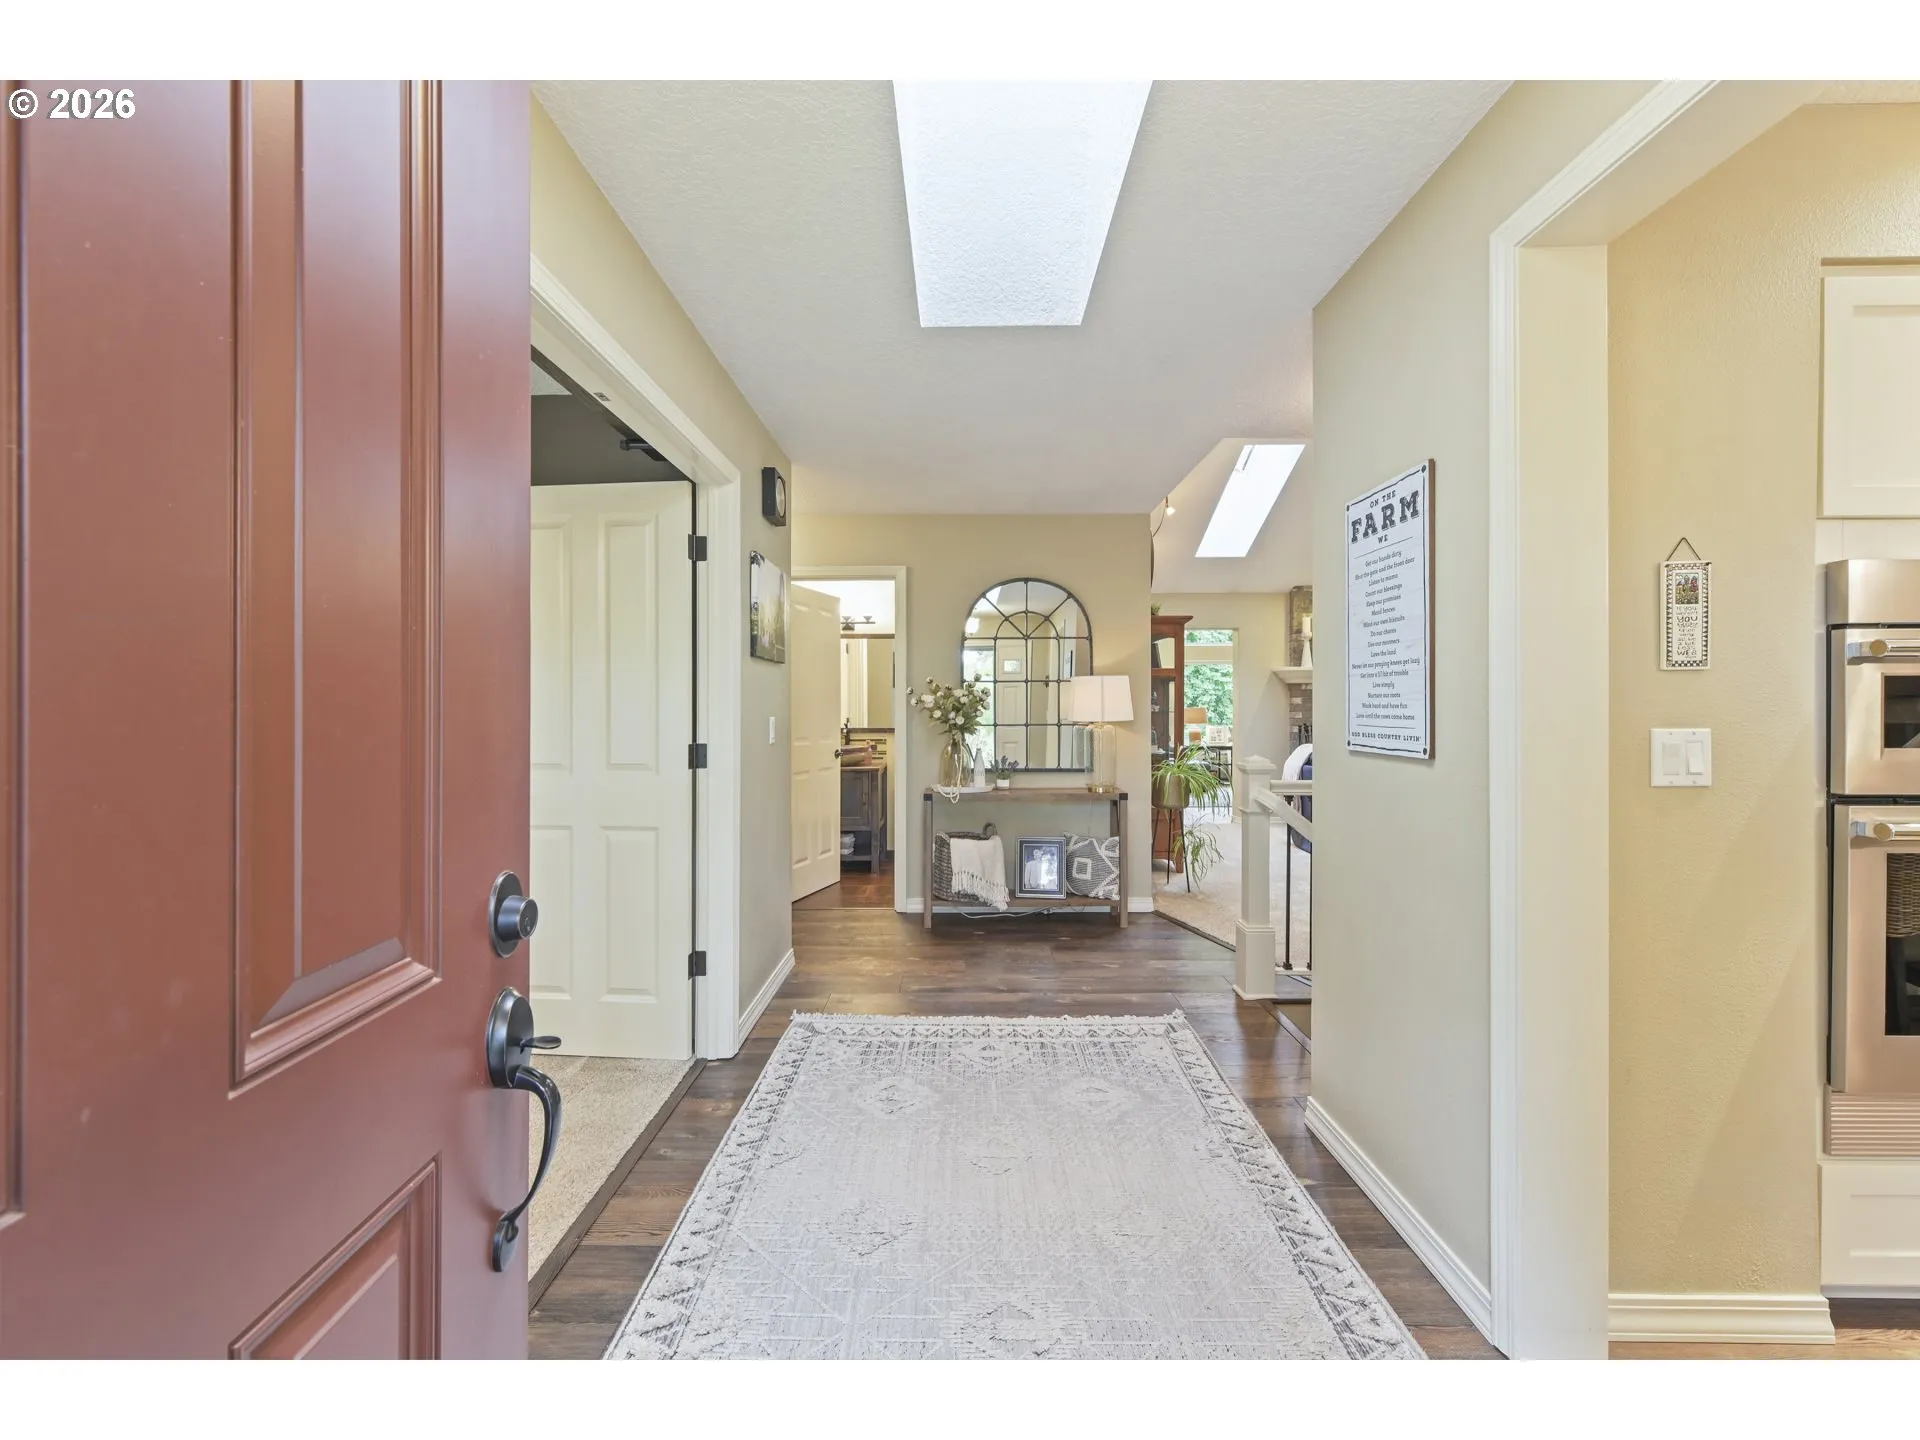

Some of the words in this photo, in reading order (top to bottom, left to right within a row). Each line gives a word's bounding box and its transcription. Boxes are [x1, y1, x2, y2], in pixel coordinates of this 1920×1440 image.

[1370, 499, 1378, 508] ON
[1382, 490, 1395, 502] THE
[1351, 490, 1420, 544] FARM
[1378, 534, 1388, 543] WE
